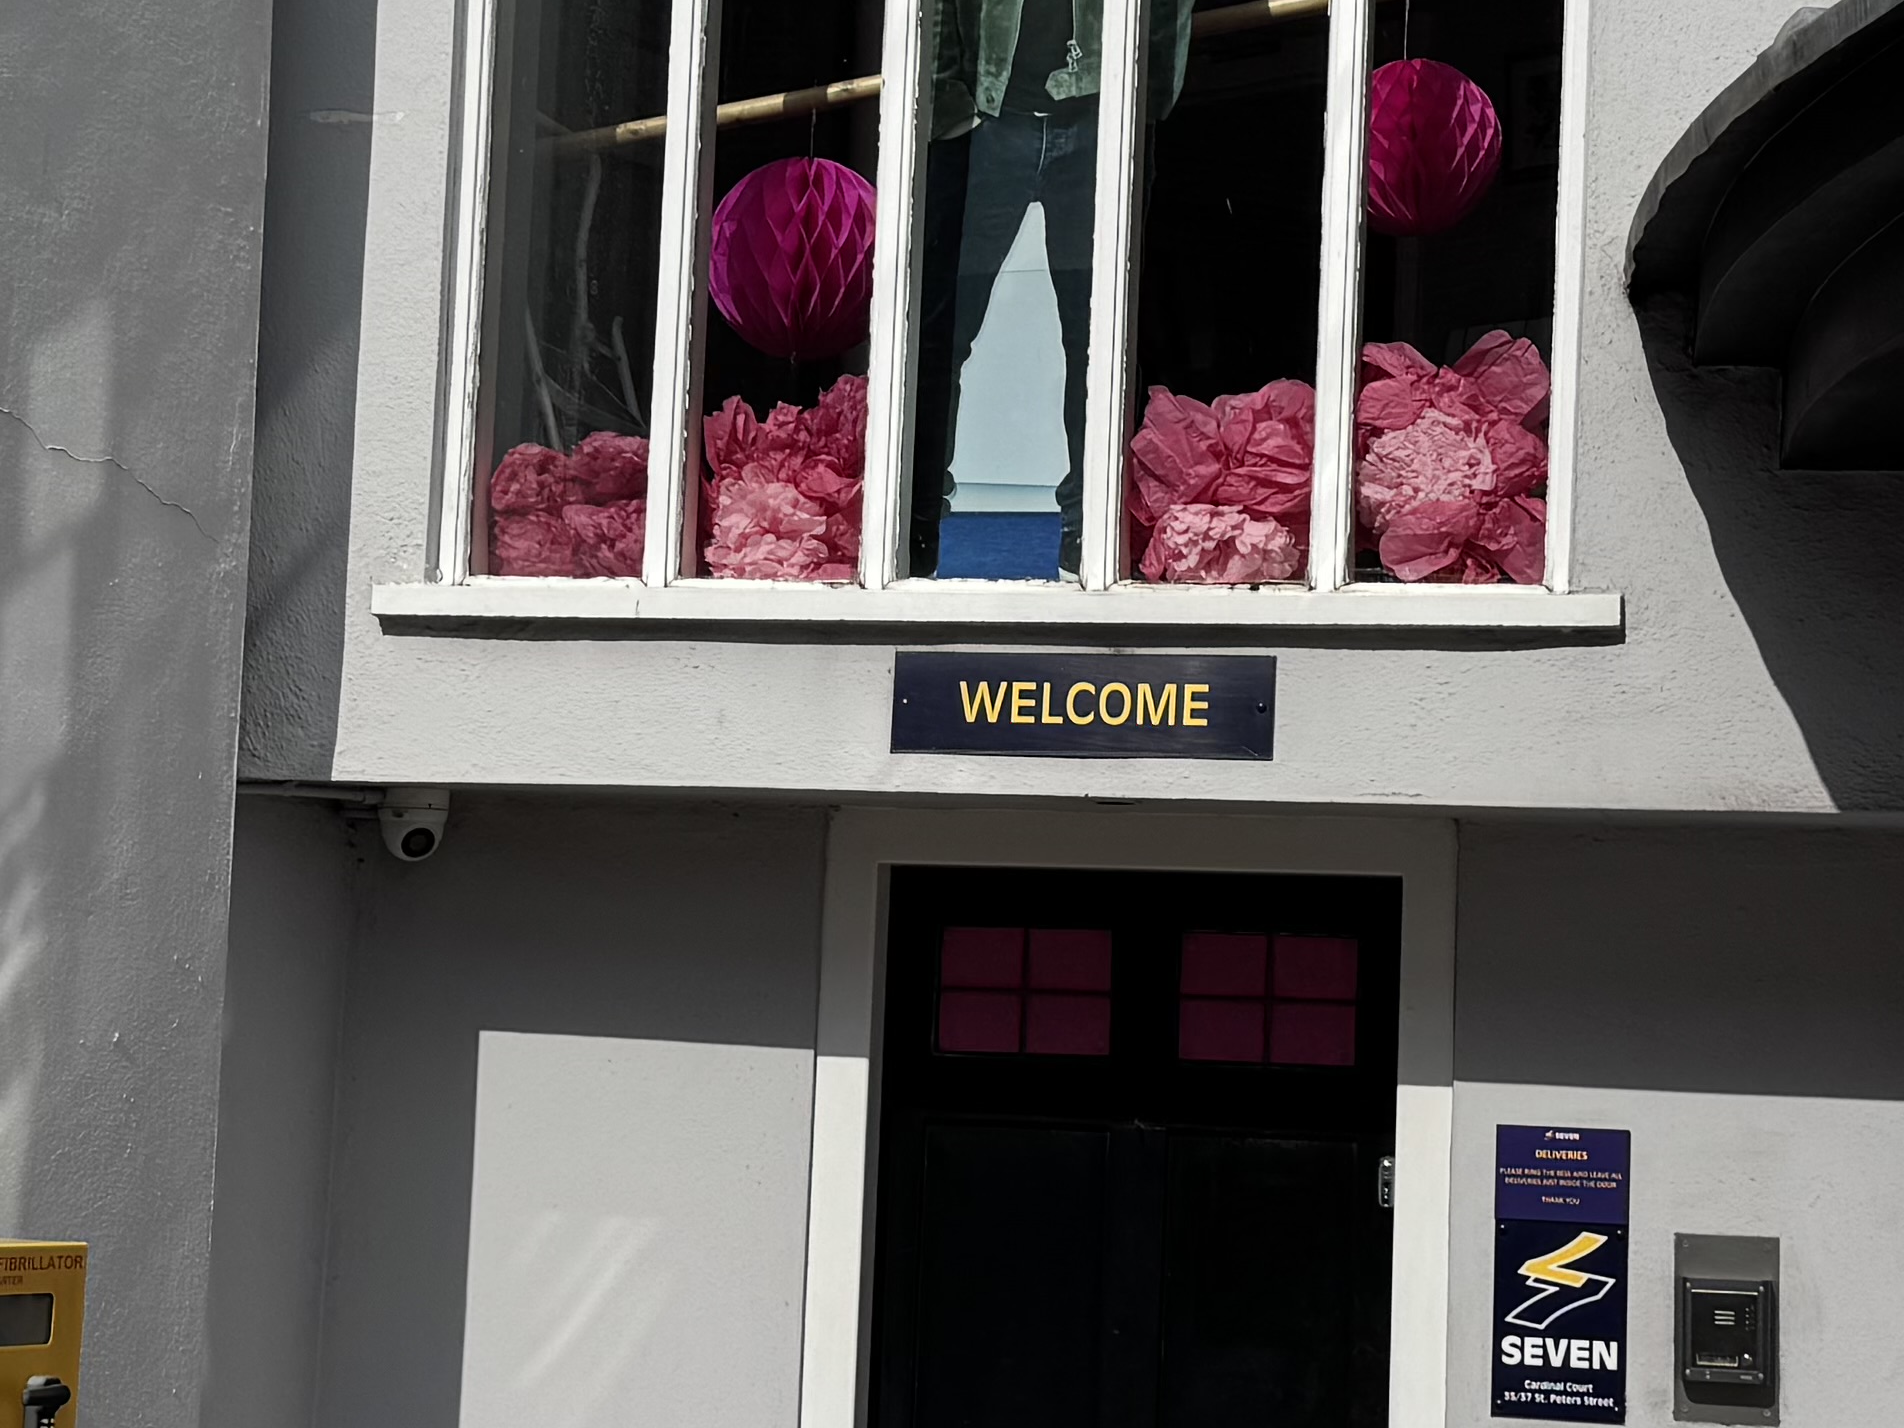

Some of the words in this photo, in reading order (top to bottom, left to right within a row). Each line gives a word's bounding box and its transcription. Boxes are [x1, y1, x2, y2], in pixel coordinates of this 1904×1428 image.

[959, 680, 1210, 727] WELCOME
[1535, 1149, 1588, 1160] DELIVERIES
[1499, 1167, 1523, 1175] PLEASE
[1589, 1171, 1609, 1180] LEAVE
[1542, 1196, 1564, 1204] THANK
[1566, 1197, 1580, 1205] YOU
[1501, 1335, 1618, 1371] SEVEN
[1524, 1379, 1564, 1391] Cardinal
[1566, 1382, 1593, 1393] Court
[1550, 1394, 1581, 1405] Peters
[1583, 1396, 1614, 1407] Street
